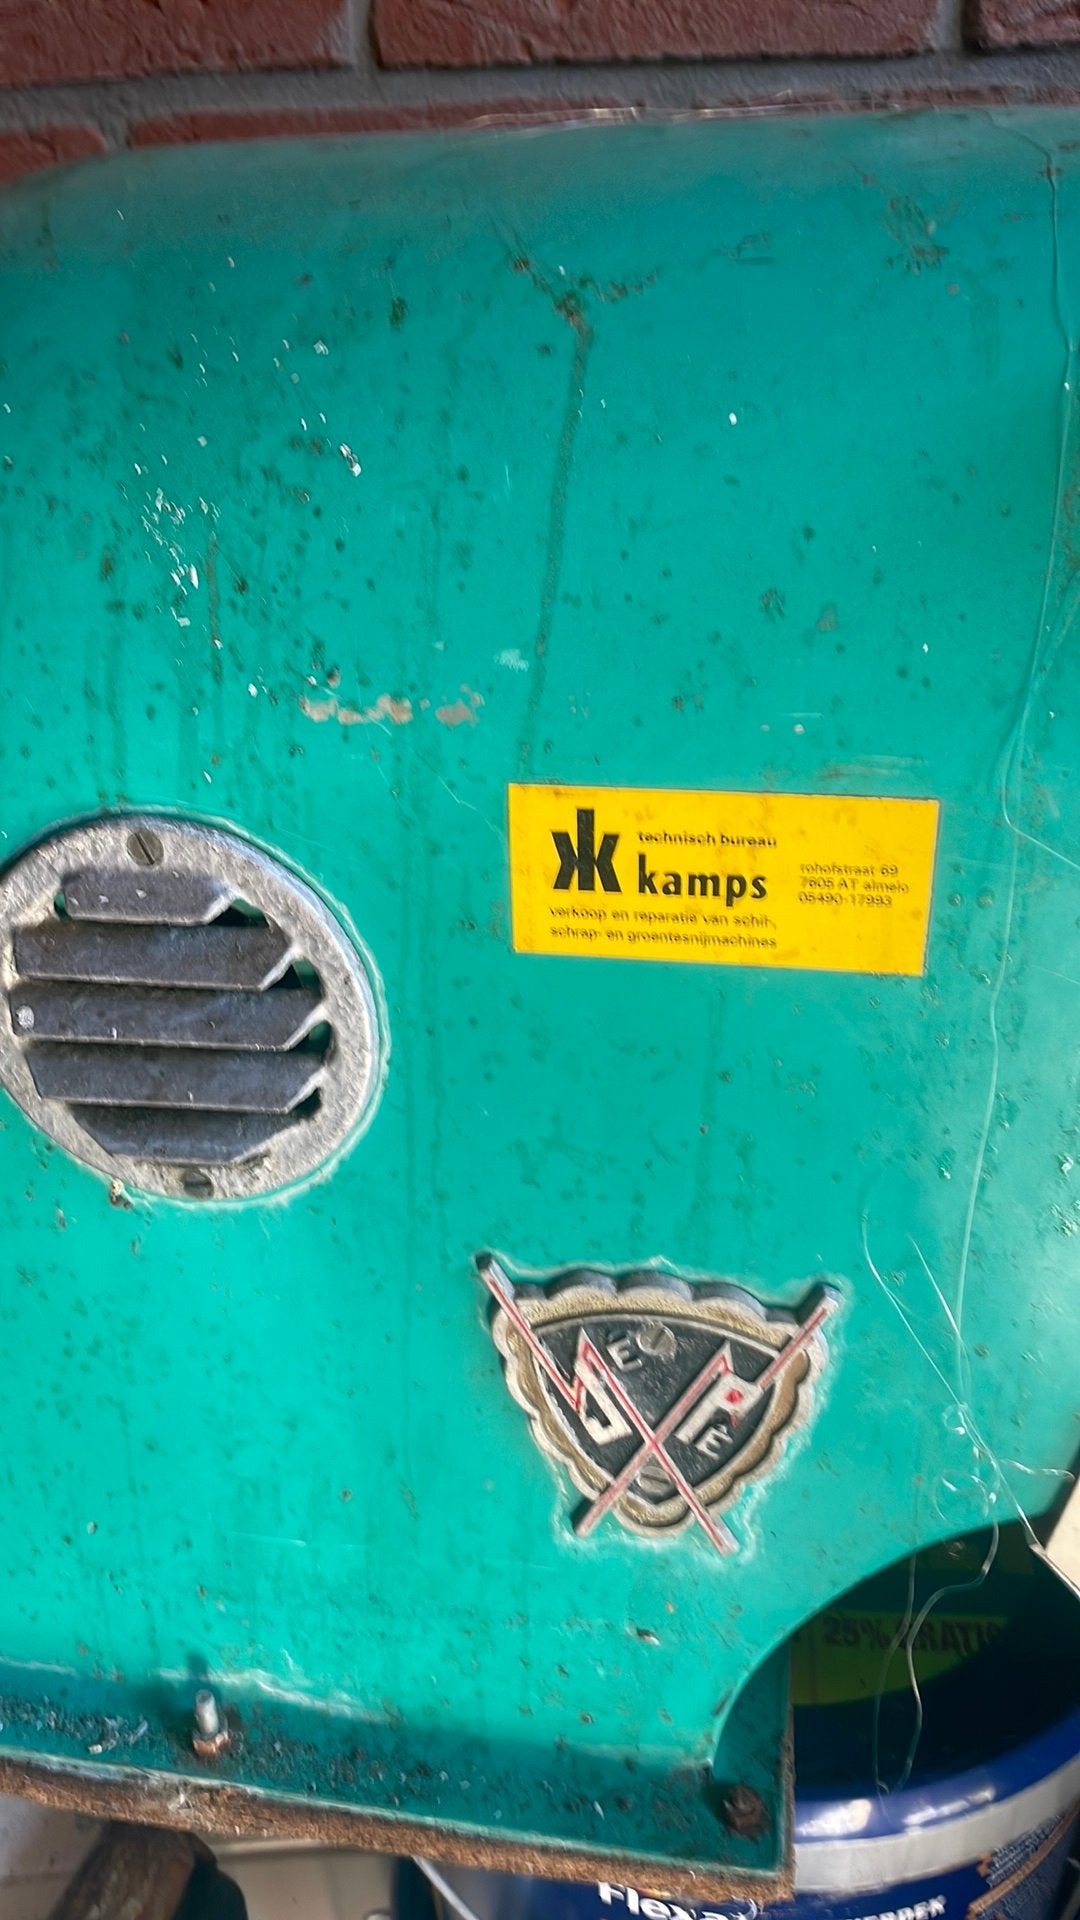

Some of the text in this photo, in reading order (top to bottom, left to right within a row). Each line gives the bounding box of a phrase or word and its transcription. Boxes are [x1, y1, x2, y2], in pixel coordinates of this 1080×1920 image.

[638, 831, 777, 848] technisch bureau
[638, 853, 767, 907] kamps
[839, 877, 858, 891] AT
[864, 880, 909, 894] almelo
[549, 906, 608, 922] verkoop
[612, 909, 629, 920] en
[633, 910, 697, 925] reparatie
[703, 914, 728, 925] van
[606, 930, 624, 941] en
[628, 929, 777, 949] groentesnijmachines
